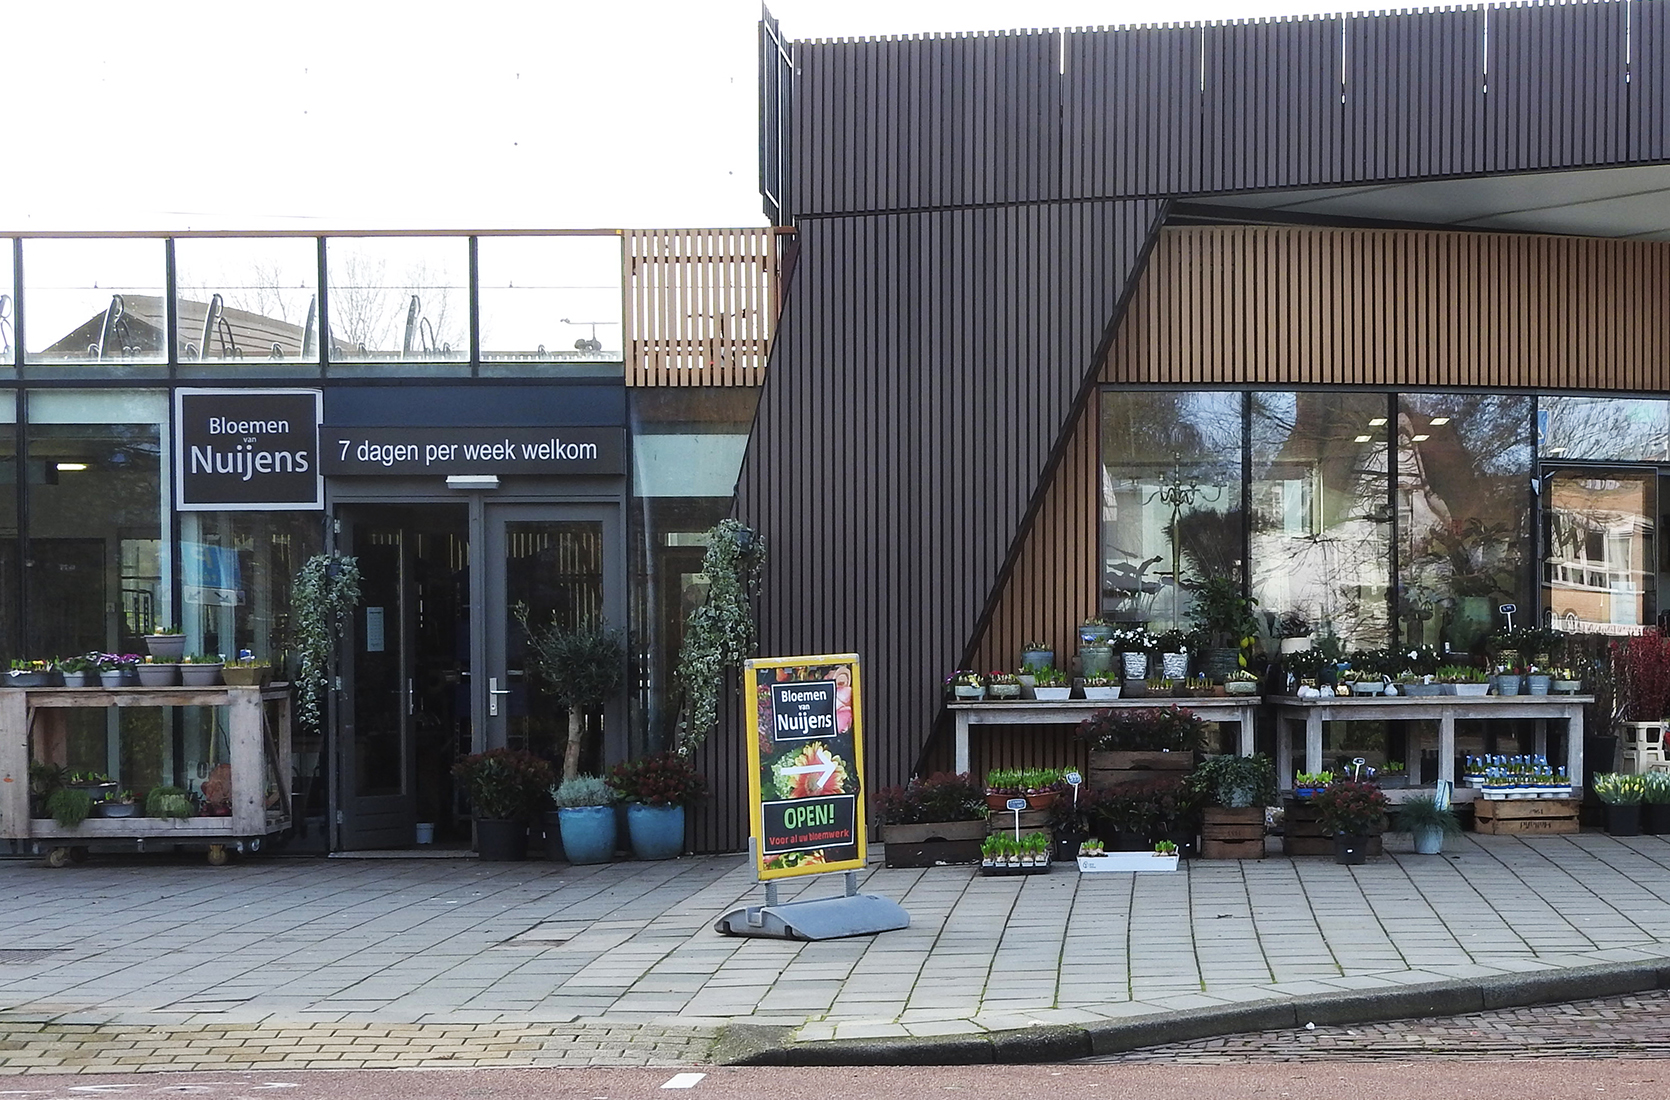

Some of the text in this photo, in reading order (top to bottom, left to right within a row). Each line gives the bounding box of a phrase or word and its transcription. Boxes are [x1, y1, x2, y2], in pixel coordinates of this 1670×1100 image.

[209, 416, 289, 435] Bloemen
[338, 438, 597, 466] 7 dagen per week welkom
[190, 445, 309, 481] Nuijens
[781, 690, 827, 702] Bloemen
[798, 703, 811, 711] van
[777, 712, 832, 734] Nuijens
[784, 804, 834, 829] OPEN!
[769, 837, 789, 845] Voor
[790, 834, 798, 844] al
[808, 829, 850, 841] bloemwerk
